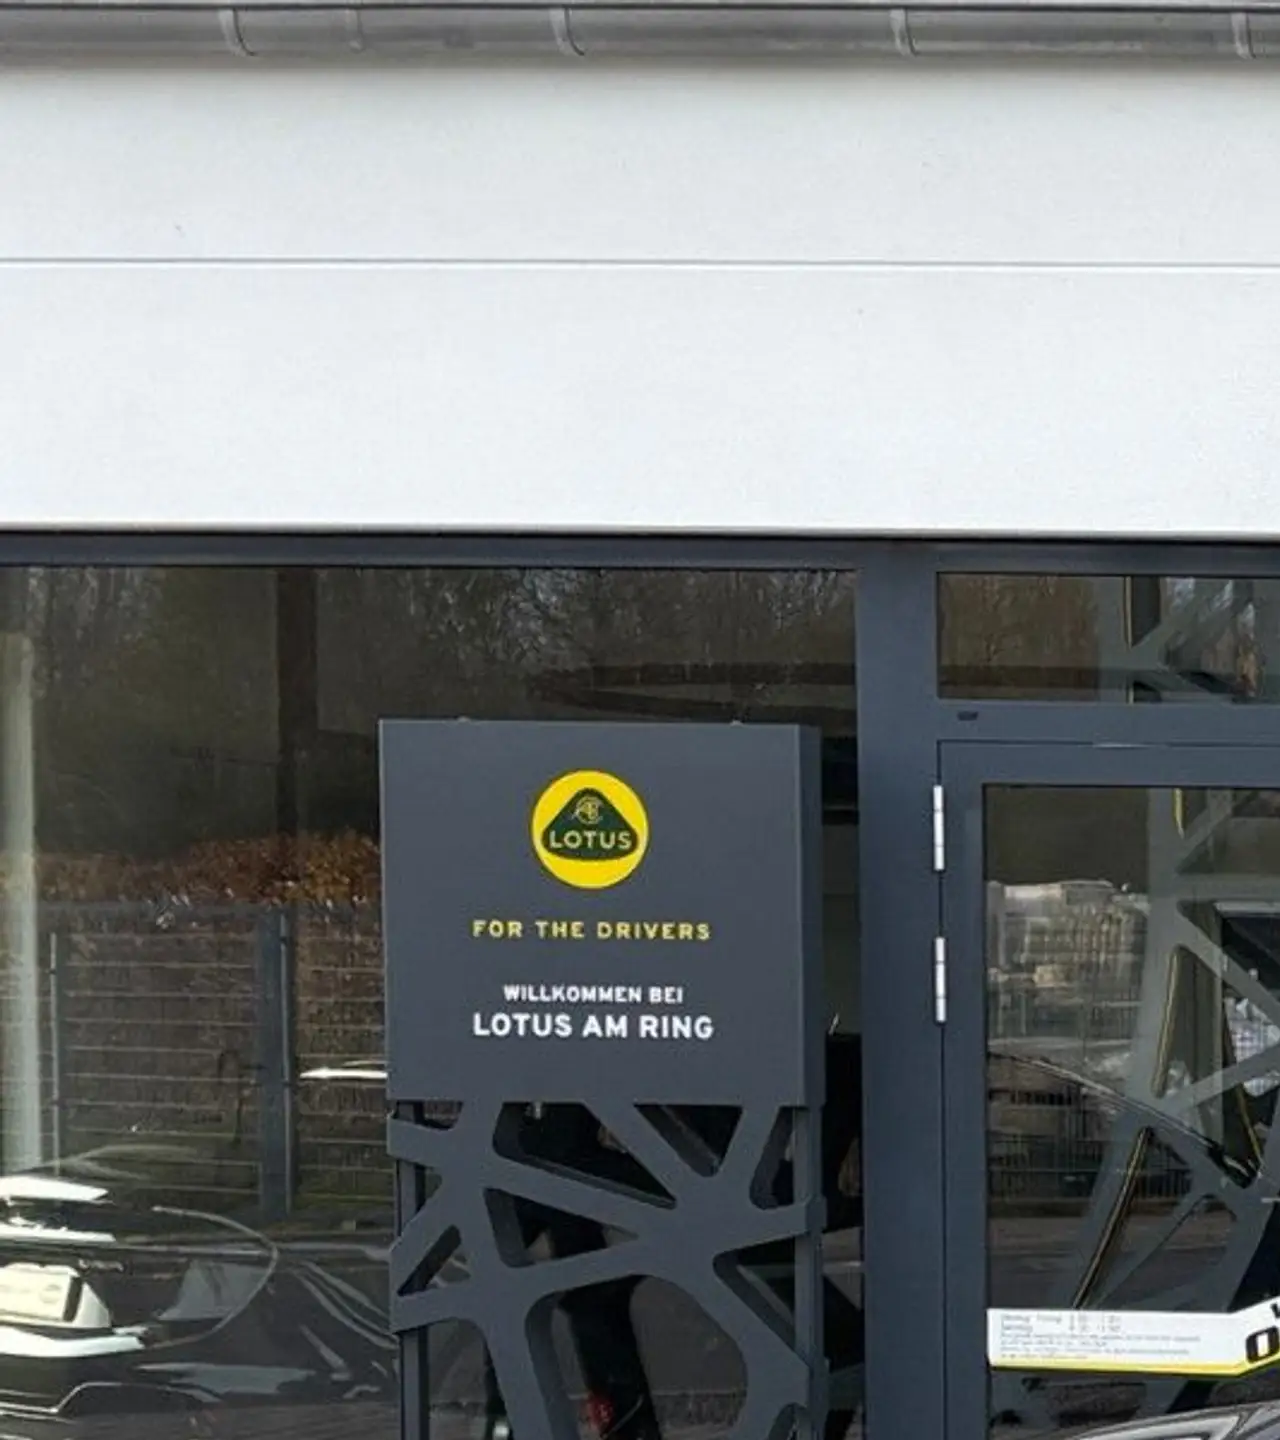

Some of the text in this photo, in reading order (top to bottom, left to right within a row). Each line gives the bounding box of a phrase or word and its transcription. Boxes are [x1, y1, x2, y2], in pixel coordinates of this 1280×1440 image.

[550, 830, 632, 850] LOTUS
[472, 920, 711, 940] FOR THE DRIVERS
[503, 985, 684, 1004] WILLKOMMEN BEI
[472, 1013, 714, 1040] LOTUS AM RING
